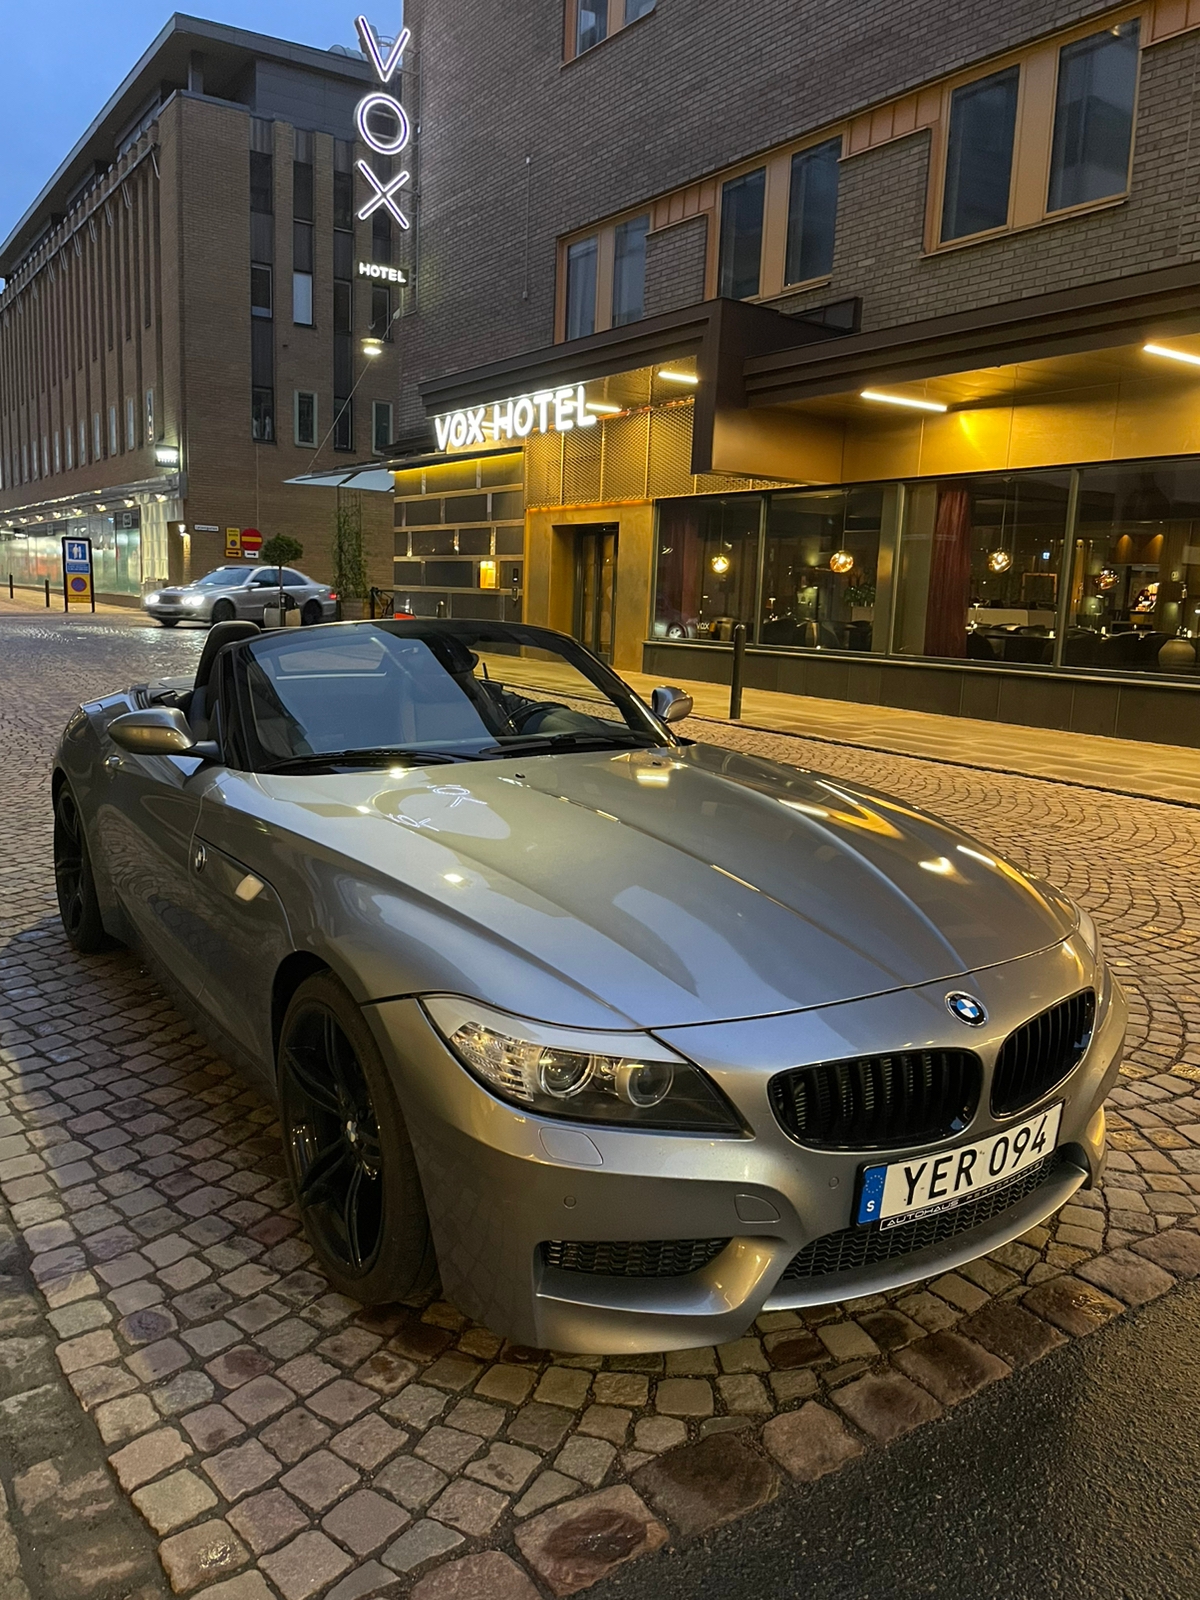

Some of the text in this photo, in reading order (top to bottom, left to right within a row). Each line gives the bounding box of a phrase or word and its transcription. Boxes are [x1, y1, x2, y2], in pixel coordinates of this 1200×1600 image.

[355, 14, 412, 230] VOX
[358, 262, 407, 284] HOTEL
[434, 385, 597, 451] VOX HOTEL
[866, 1114, 1047, 1213] S YER 094
[887, 1199, 959, 1226] AUTOHAUS
